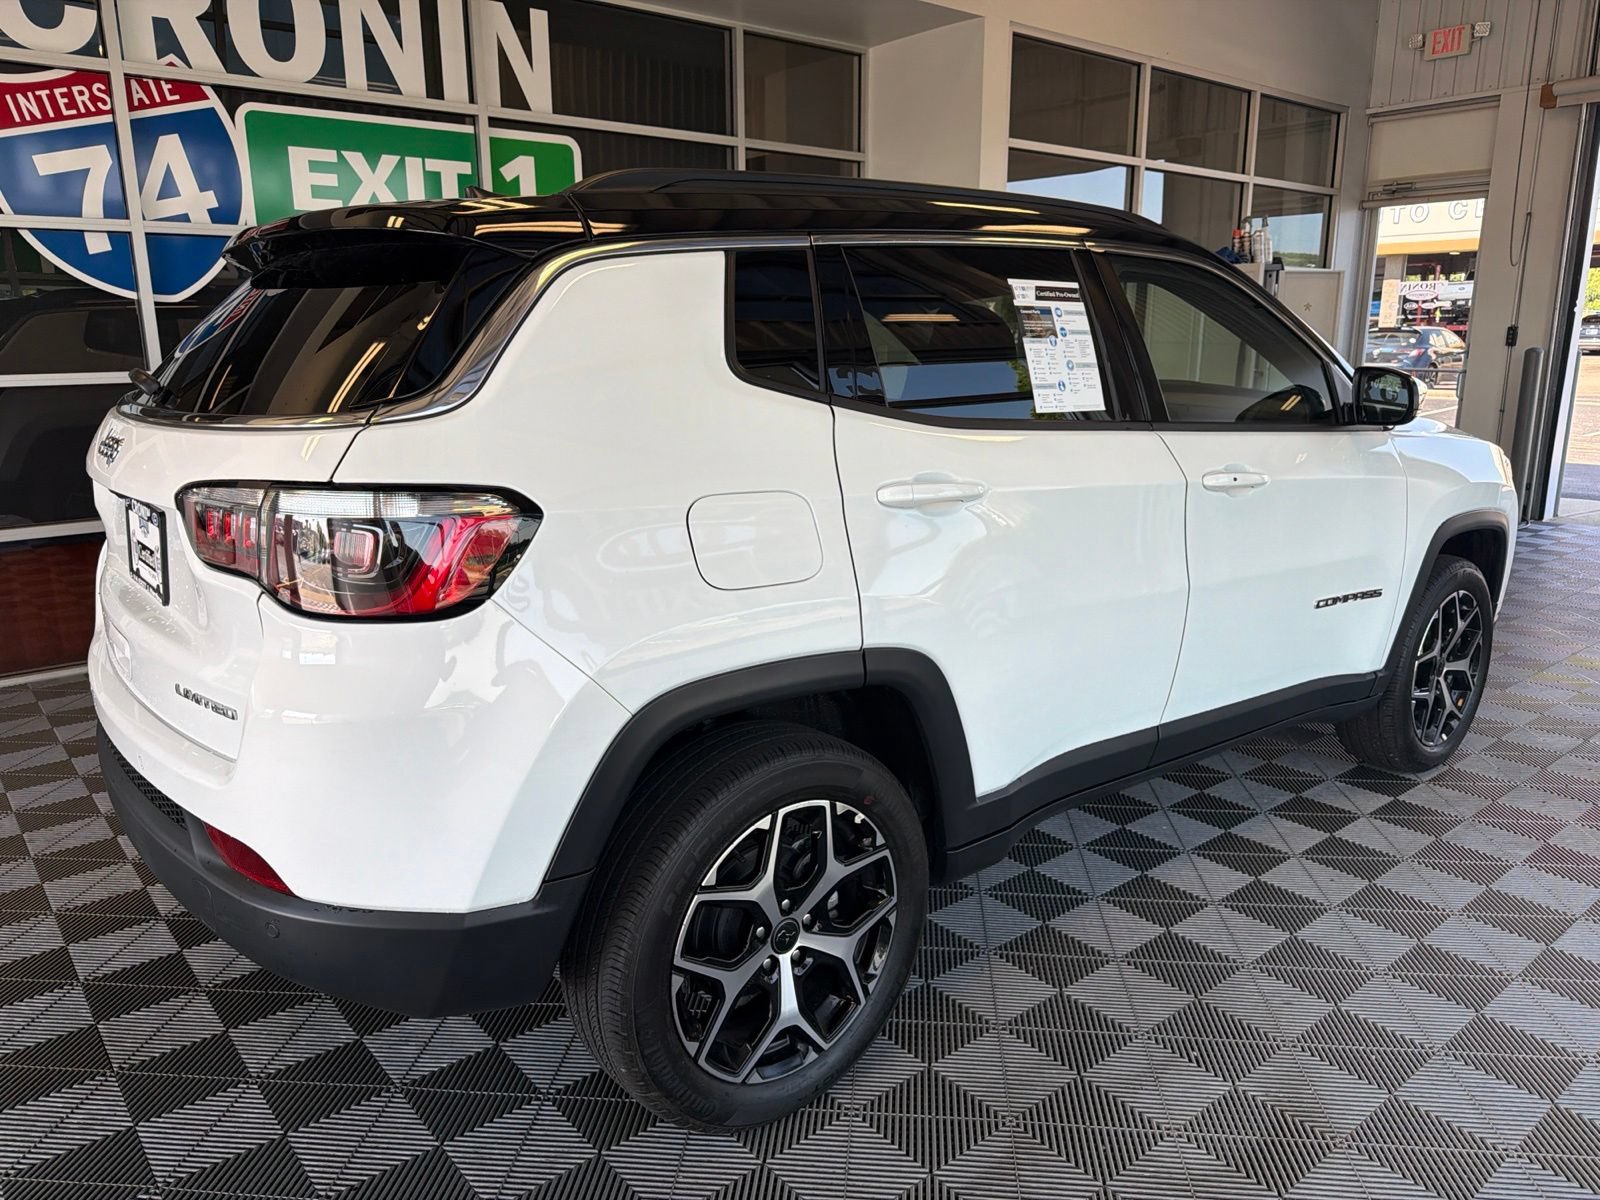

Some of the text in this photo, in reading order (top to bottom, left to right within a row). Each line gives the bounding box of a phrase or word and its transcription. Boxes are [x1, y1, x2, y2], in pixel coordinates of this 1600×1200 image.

[1432, 27, 1466, 55] EXIT
[5, 77, 181, 123] INTERSATE
[32, 133, 219, 255] 74
[288, 146, 537, 211] EXIT 1
[1314, 588, 1383, 609] COMPASS
[174, 682, 239, 721] LIMITED
